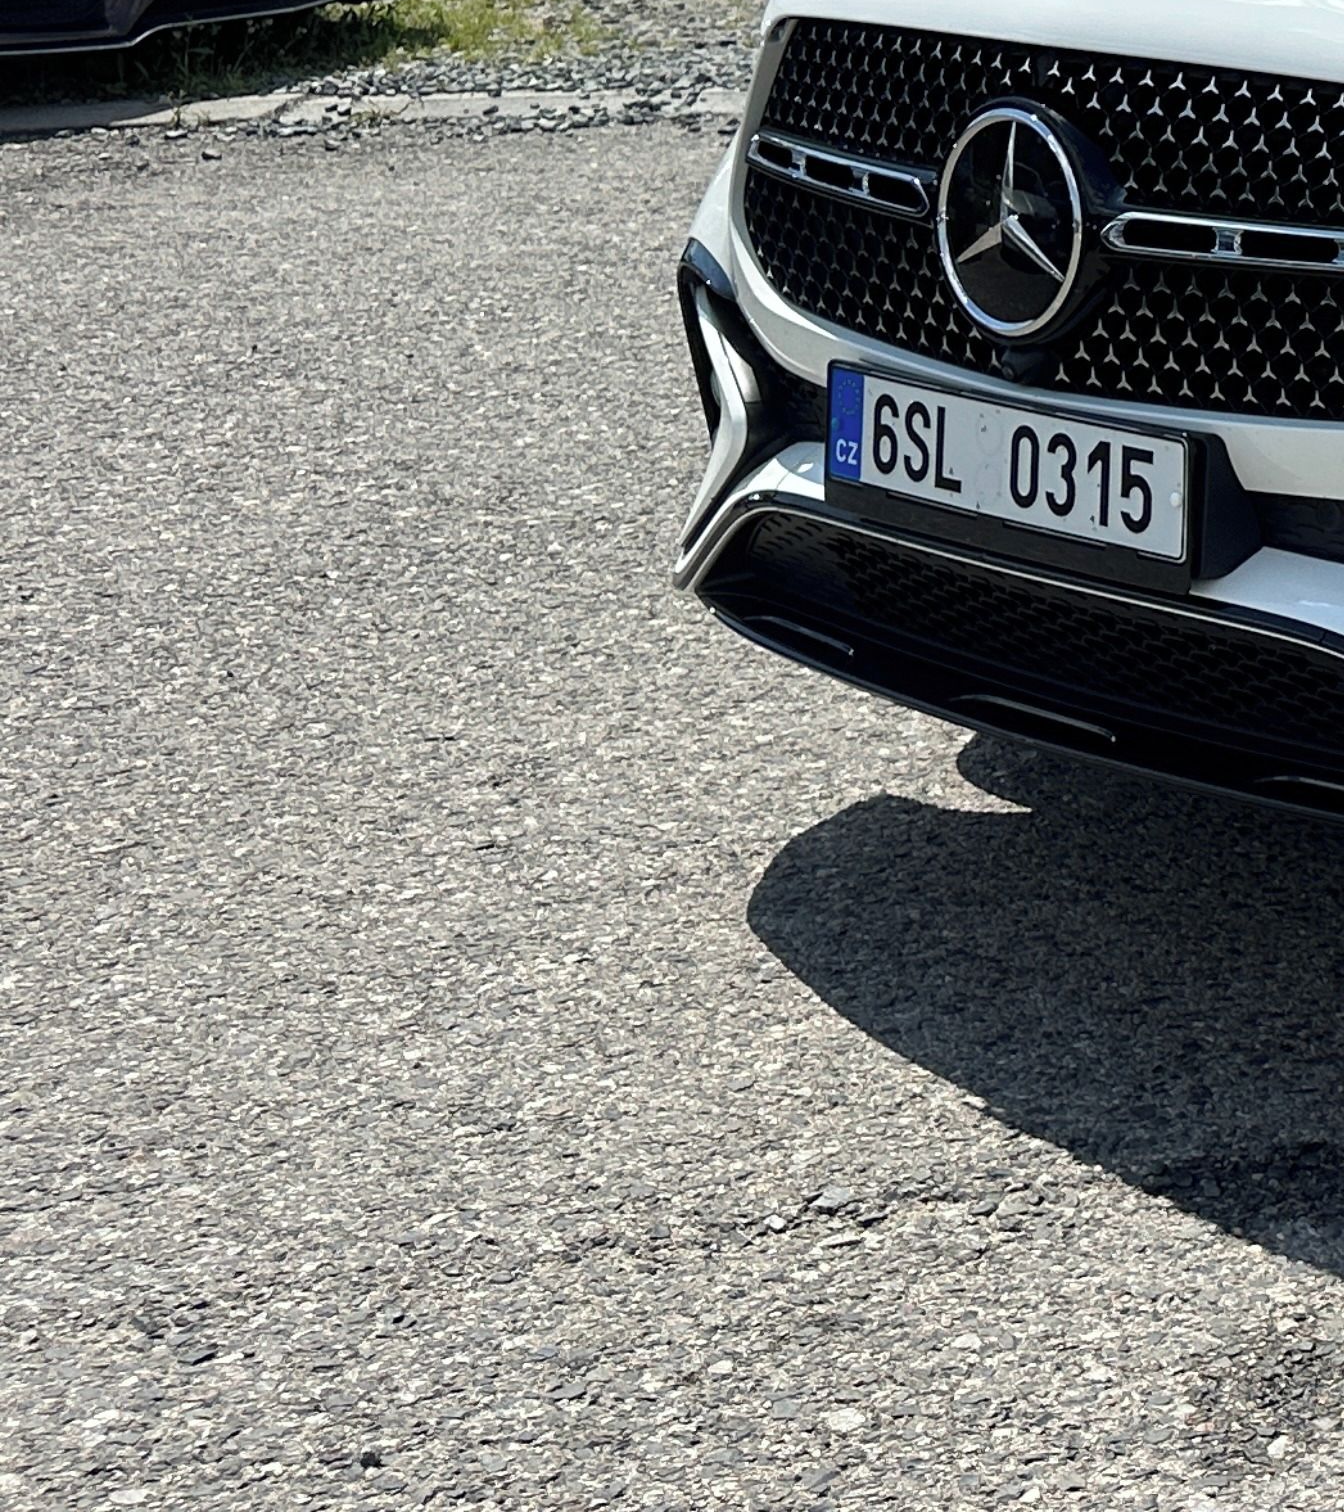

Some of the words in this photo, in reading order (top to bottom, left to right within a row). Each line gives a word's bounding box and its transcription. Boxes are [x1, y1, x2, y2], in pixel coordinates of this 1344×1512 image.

[834, 438, 859, 466] CZ
[872, 393, 963, 494] 6SL
[1008, 424, 1155, 534] 0315
